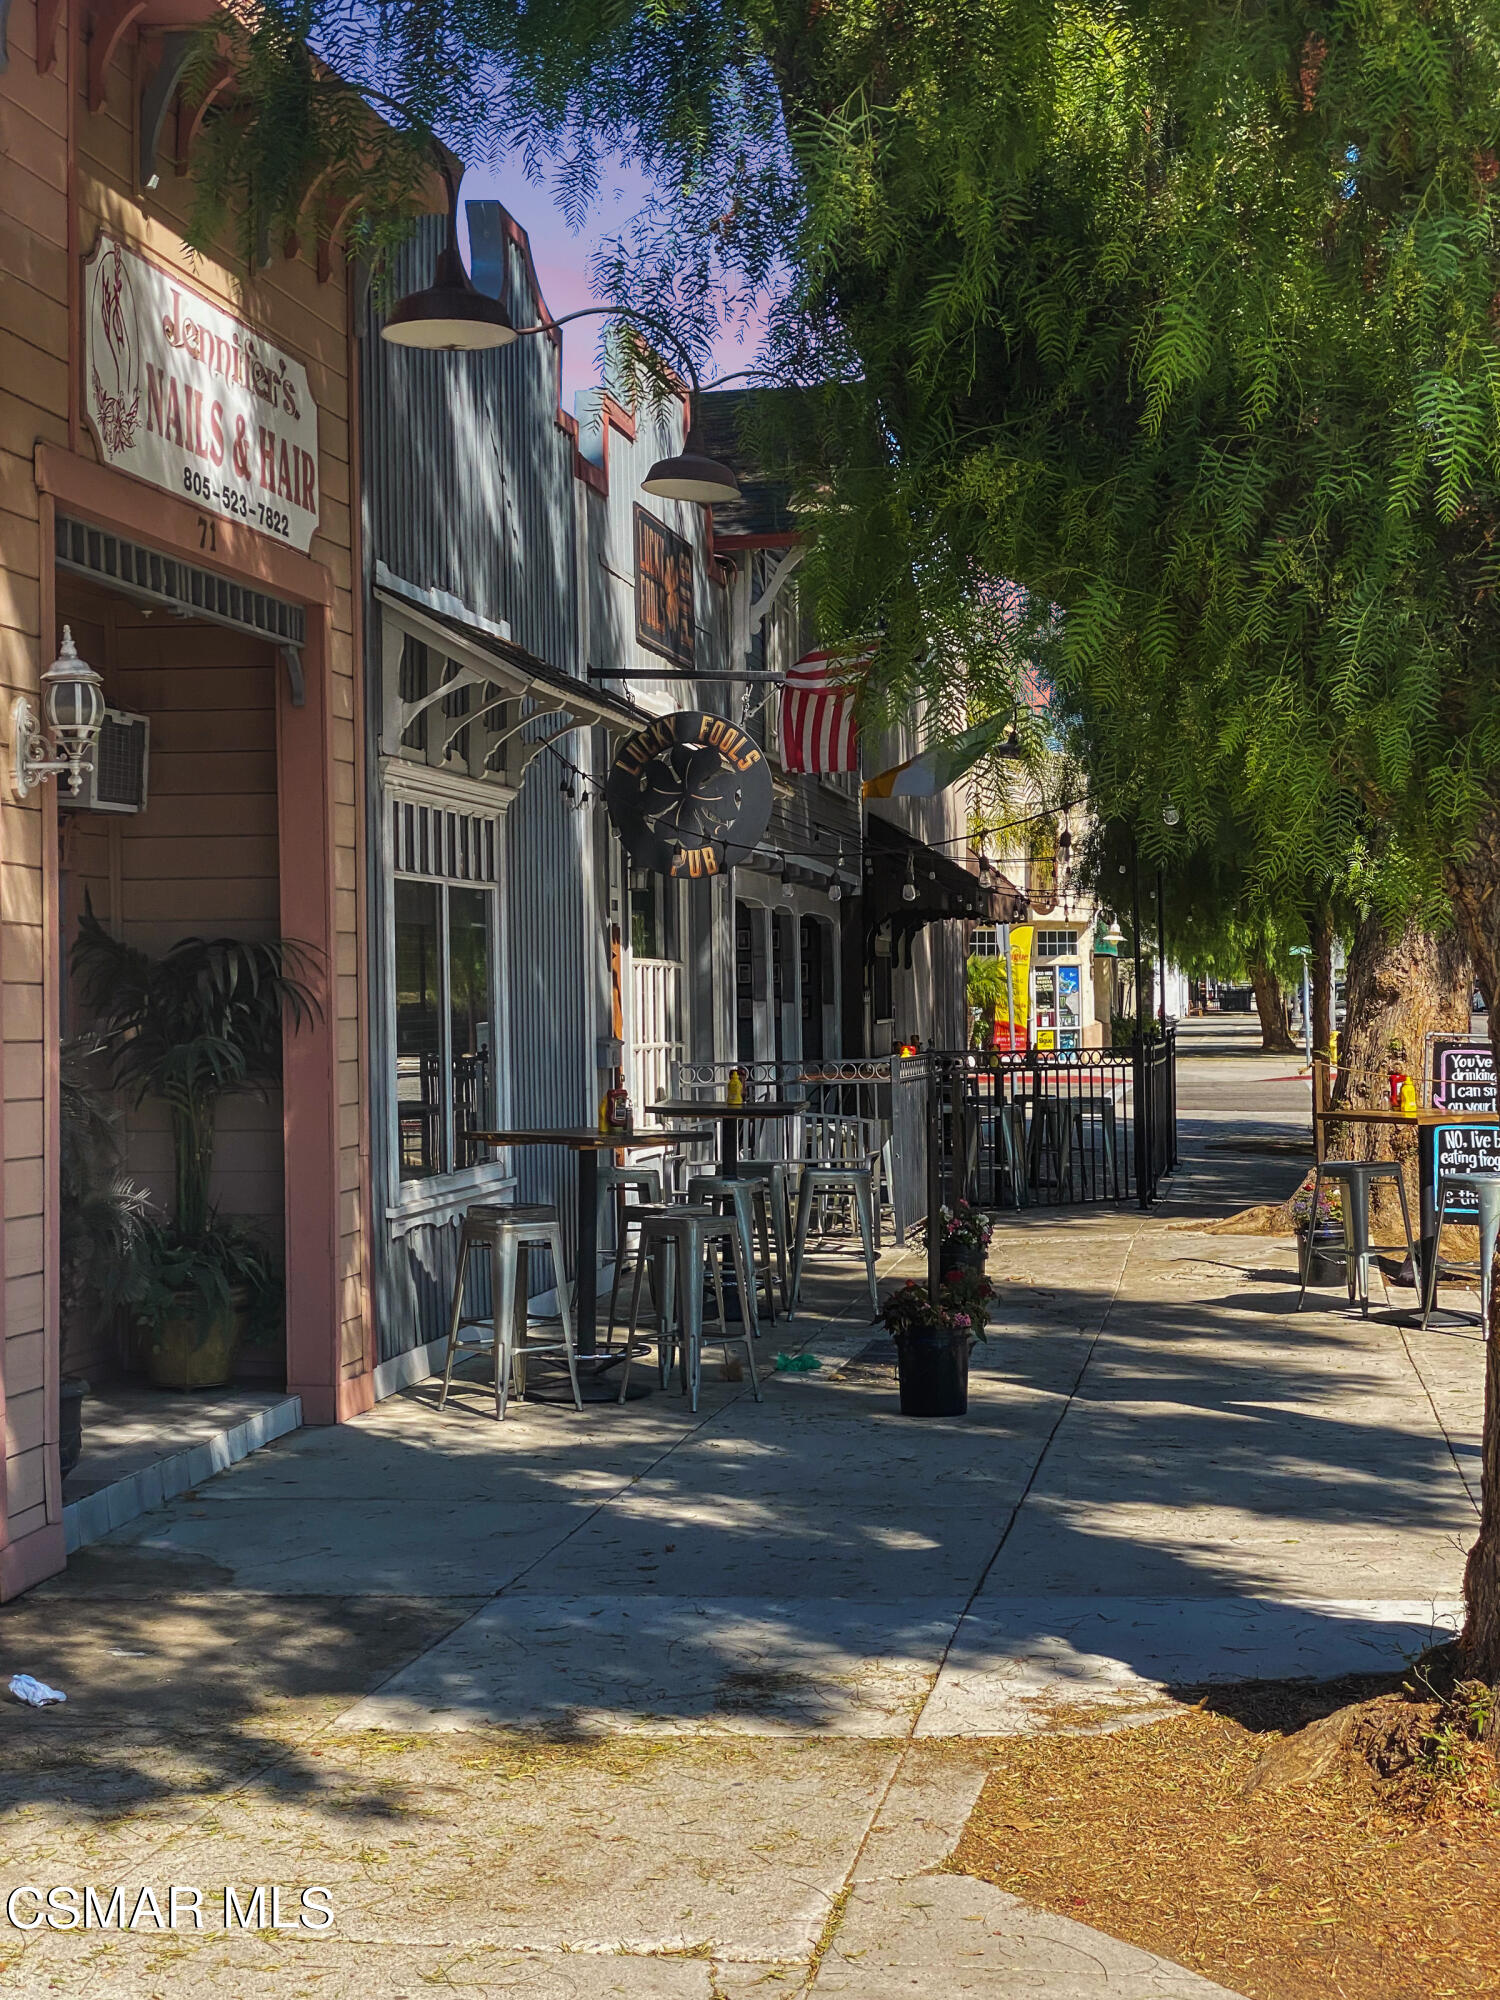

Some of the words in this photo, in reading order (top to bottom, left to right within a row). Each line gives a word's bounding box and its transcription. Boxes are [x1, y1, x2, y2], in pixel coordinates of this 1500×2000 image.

[146, 362, 224, 468] NAILS
[232, 414, 252, 483] &
[259, 426, 316, 515] HAIR
[184, 466, 290, 538] 805-523-7822
[198, 516, 217, 553] 71
[639, 518, 665, 585] LUCKY
[615, 715, 677, 777] LUCKY
[698, 715, 761, 772] FOOLS
[670, 846, 719, 878] PUB
[1451, 1055, 1493, 1069] You've
[1457, 1086, 1481, 1098] can
[1445, 1131, 1468, 1149] NO,
[1440, 1149, 1478, 1169] eating
